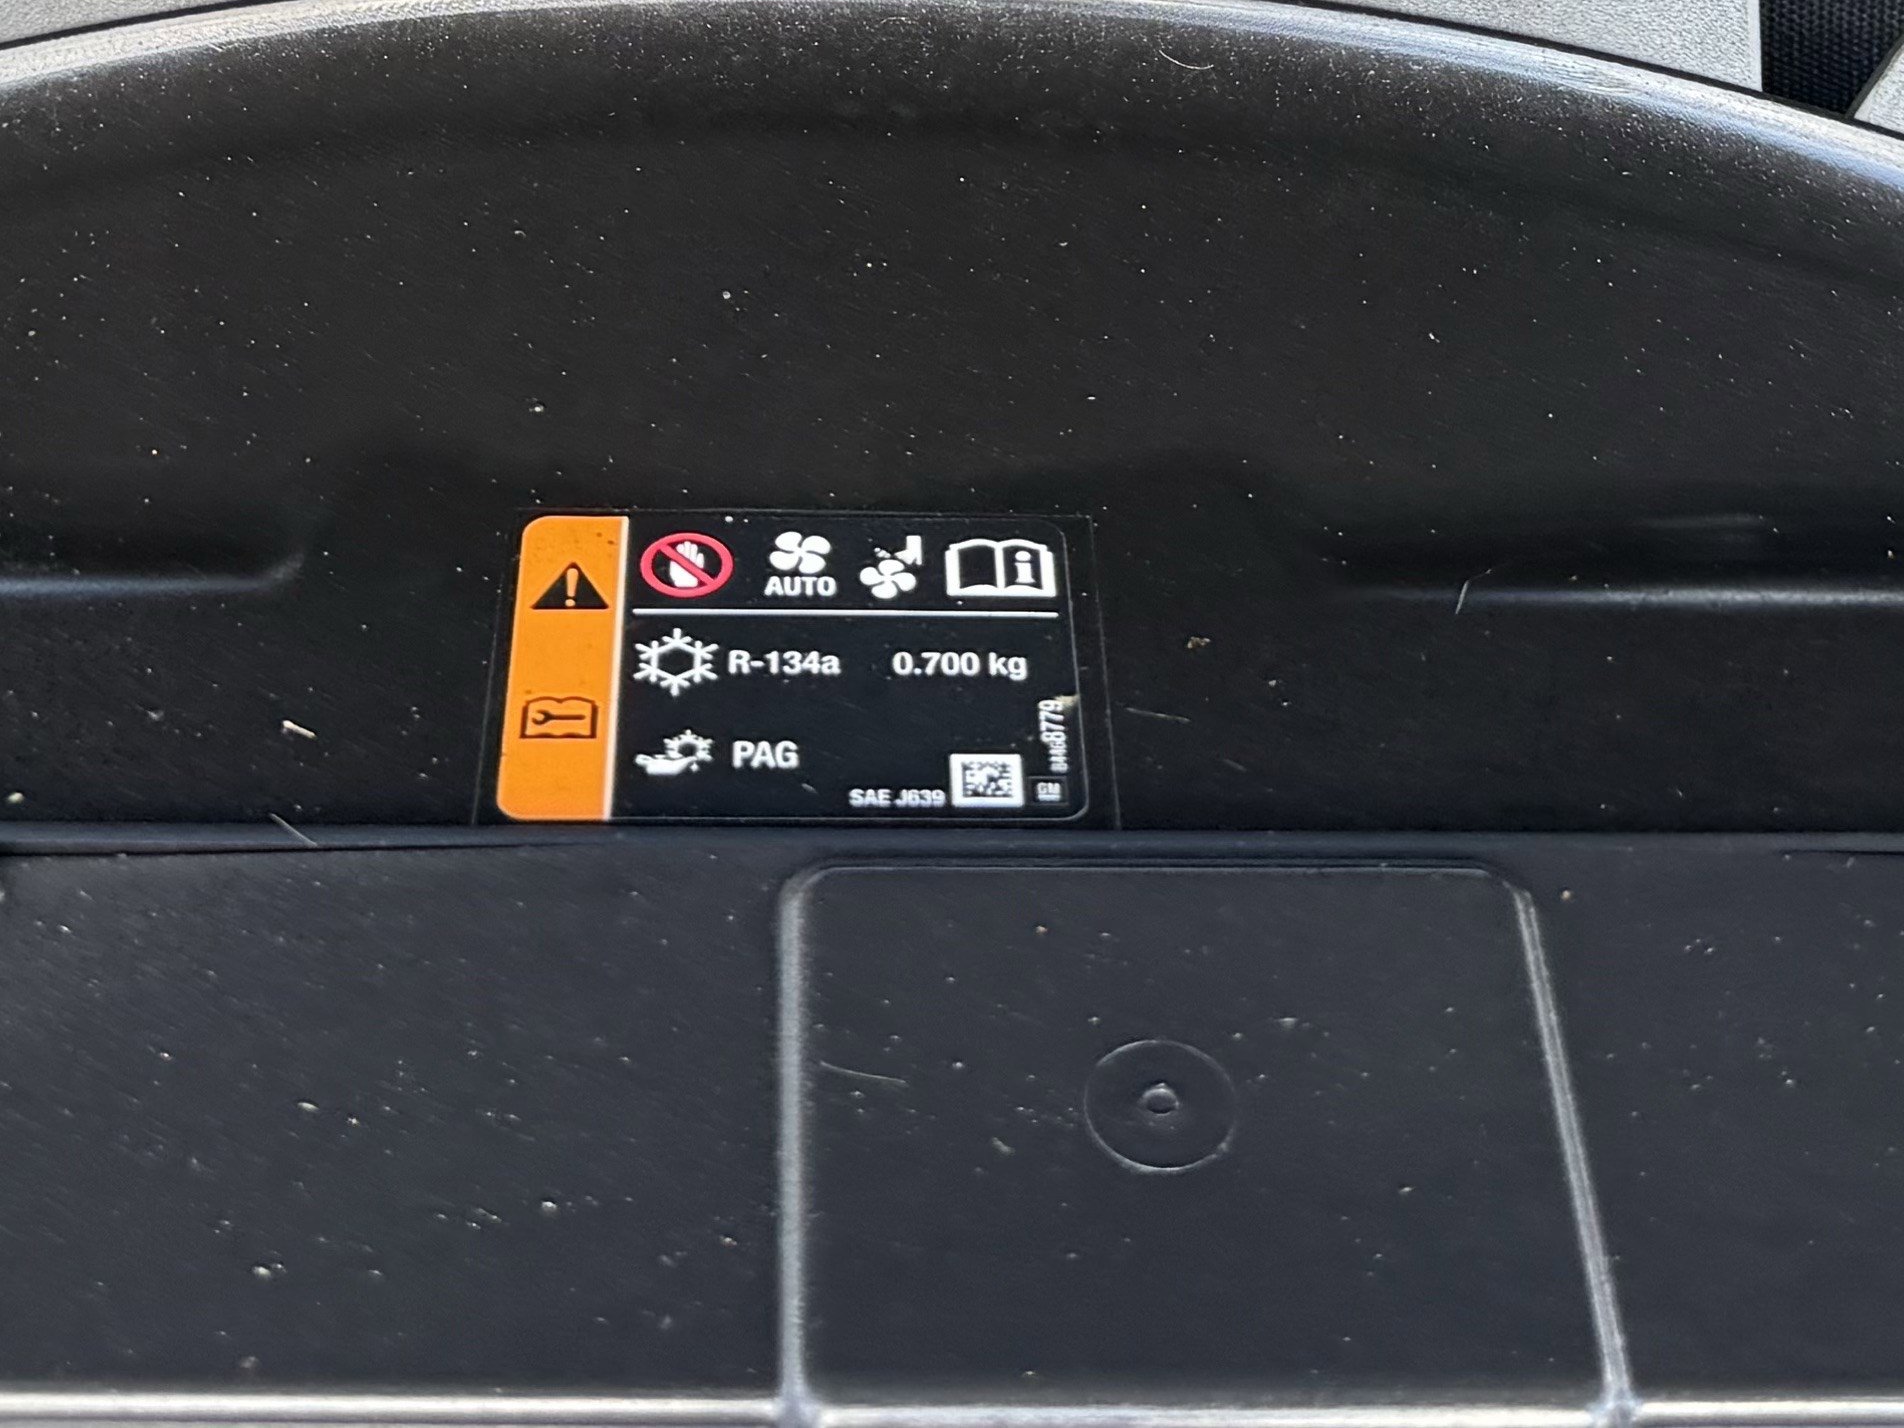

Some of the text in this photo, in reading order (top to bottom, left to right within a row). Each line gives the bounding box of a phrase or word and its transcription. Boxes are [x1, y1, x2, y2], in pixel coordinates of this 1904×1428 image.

[764, 574, 837, 597] AUTO
[728, 651, 841, 676] R-134a
[892, 651, 1028, 680] 0.700 kg
[732, 740, 799, 769] PAG
[849, 789, 946, 809] SAE J639
